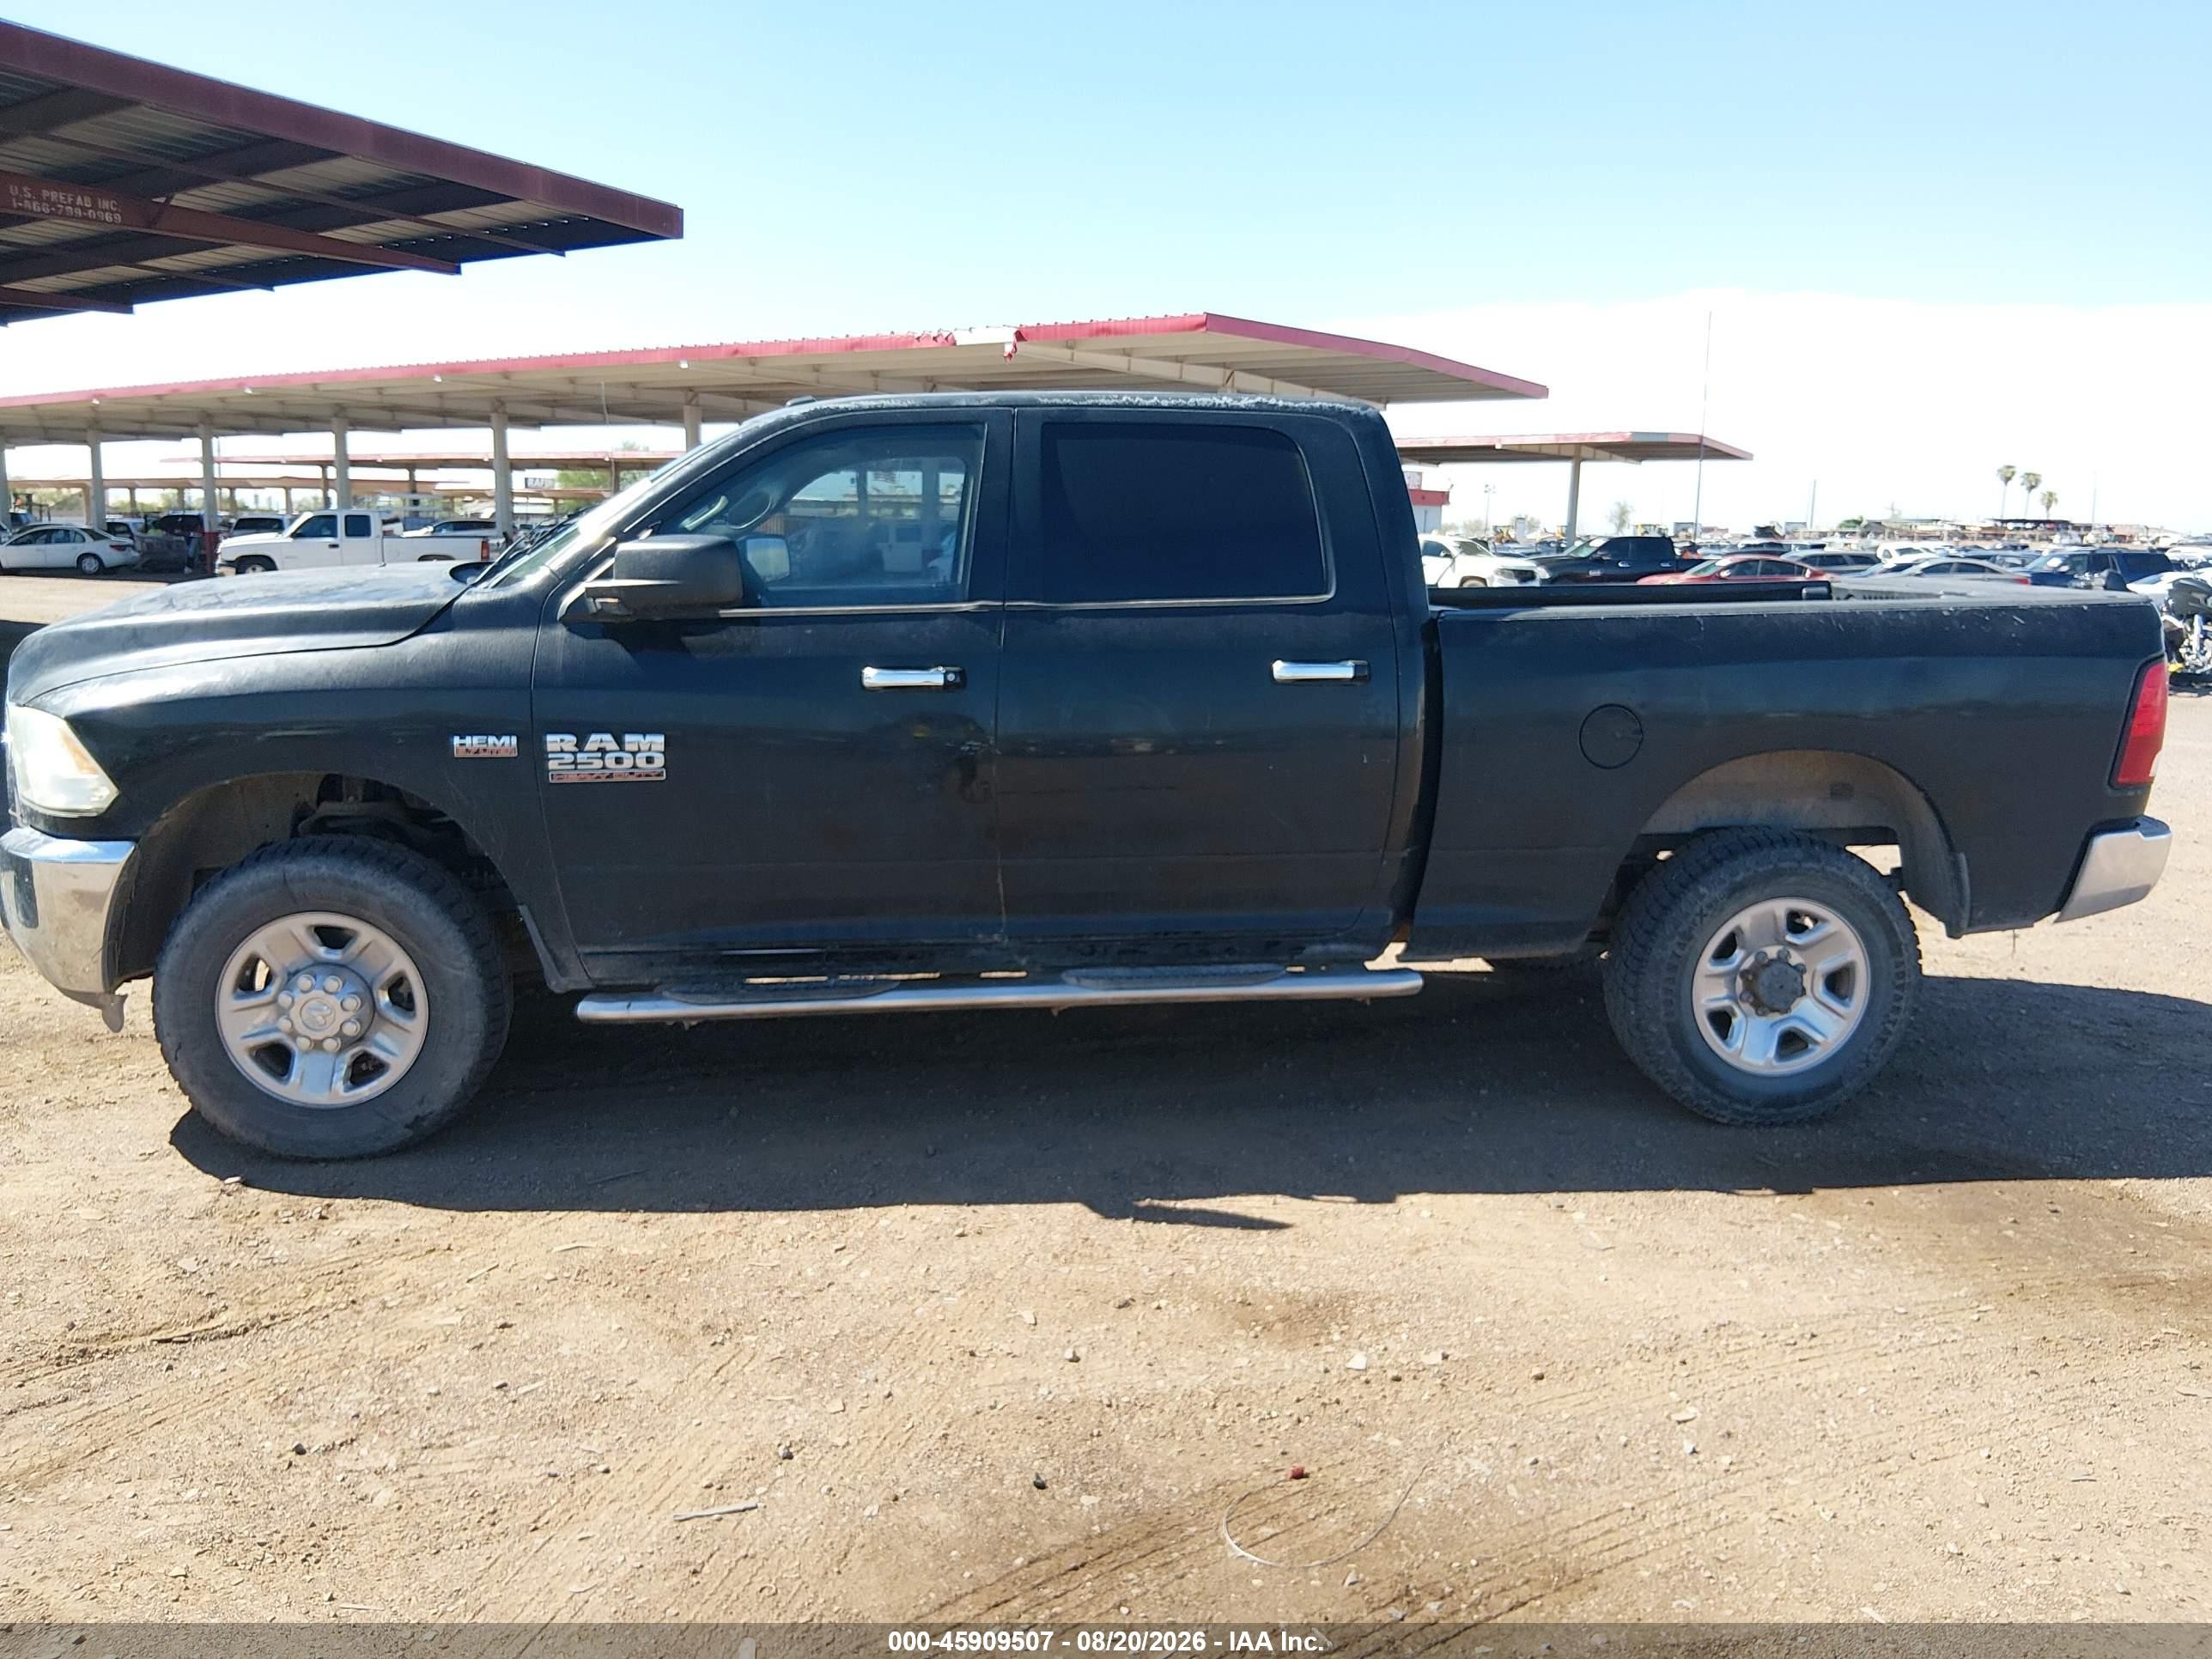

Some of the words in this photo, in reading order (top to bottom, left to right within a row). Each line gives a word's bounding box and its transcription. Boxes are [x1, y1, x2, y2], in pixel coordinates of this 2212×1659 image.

[9, 185, 36, 199] U.S.
[41, 189, 93, 208] PREFAB
[98, 198, 122, 213] INC.
[453, 735, 517, 747] HEMI
[546, 733, 665, 752] RAM
[548, 752, 665, 769] 2500
